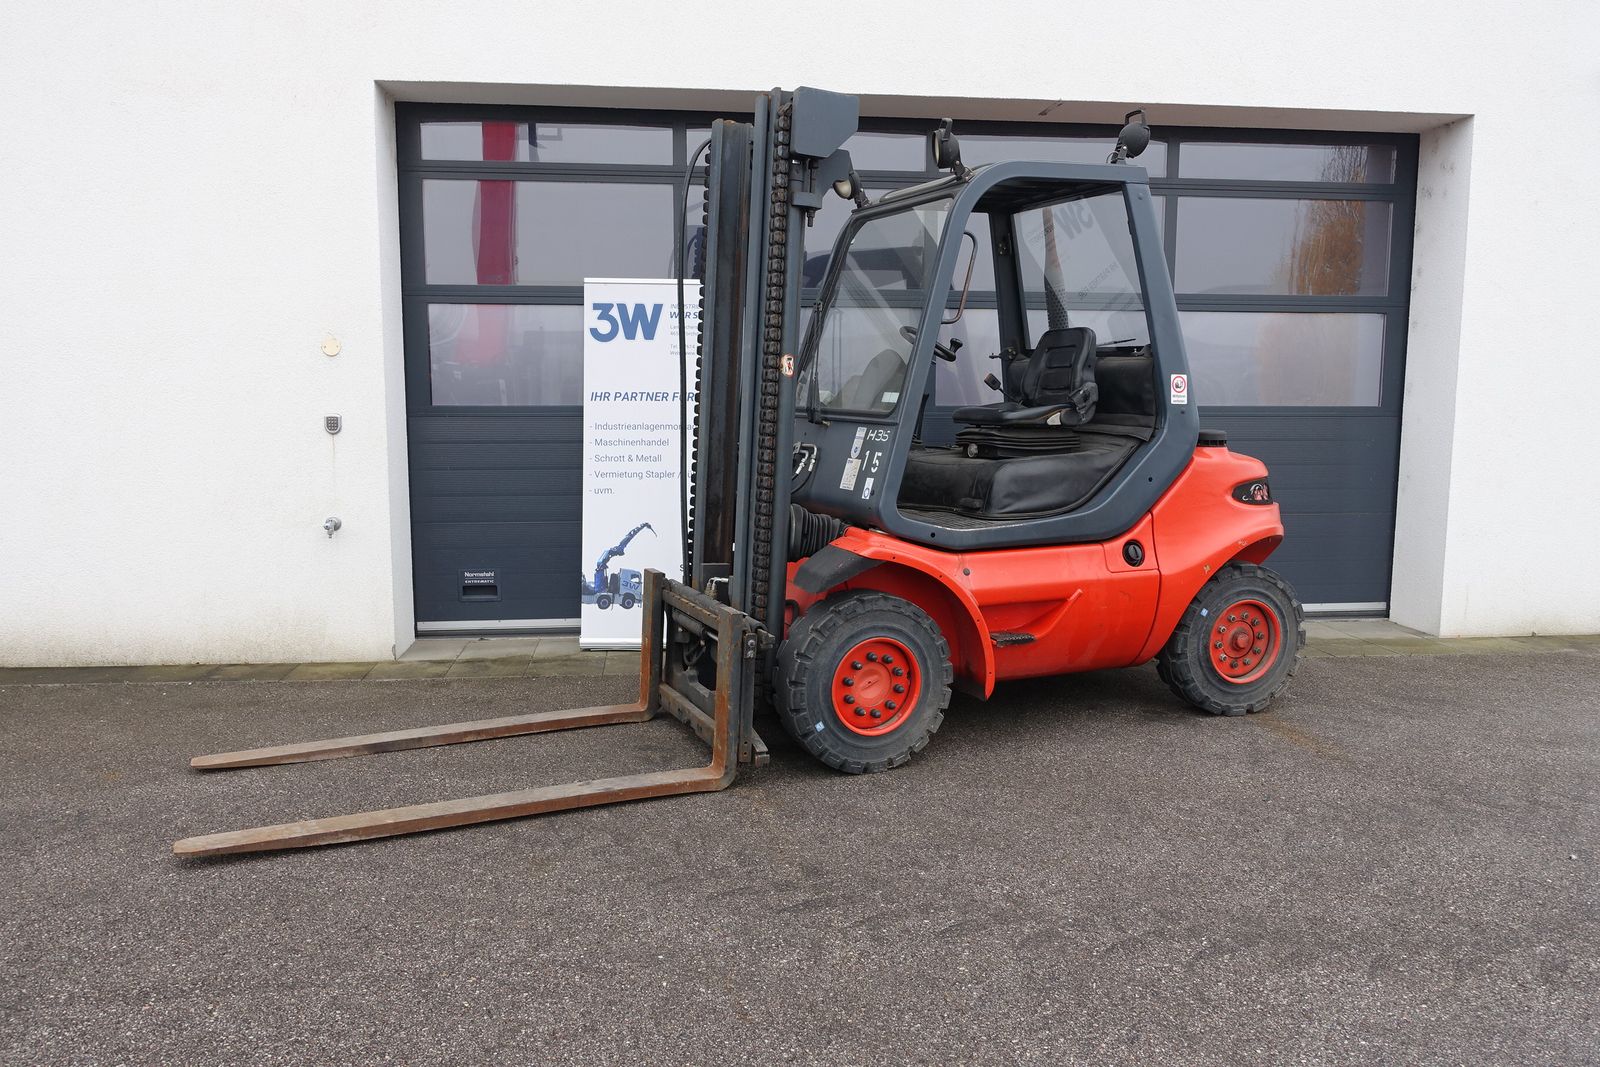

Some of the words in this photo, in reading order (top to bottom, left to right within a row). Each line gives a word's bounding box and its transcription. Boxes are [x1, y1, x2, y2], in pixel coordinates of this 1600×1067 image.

[669, 311, 691, 319] WR
[589, 303, 663, 342] 3W
[590, 392, 611, 402] IHR
[613, 392, 669, 402] PARTNER
[672, 392, 695, 402] FR
[867, 429, 891, 442] H35
[594, 438, 670, 446] Maschinenhandel
[594, 454, 625, 462] Schrott
[627, 454, 633, 462] &
[635, 454, 662, 462] Metall
[862, 450, 883, 473] 15
[594, 470, 643, 480] Vermietung
[645, 470, 676, 479] Stapler
[622, 580, 640, 590] 3W
